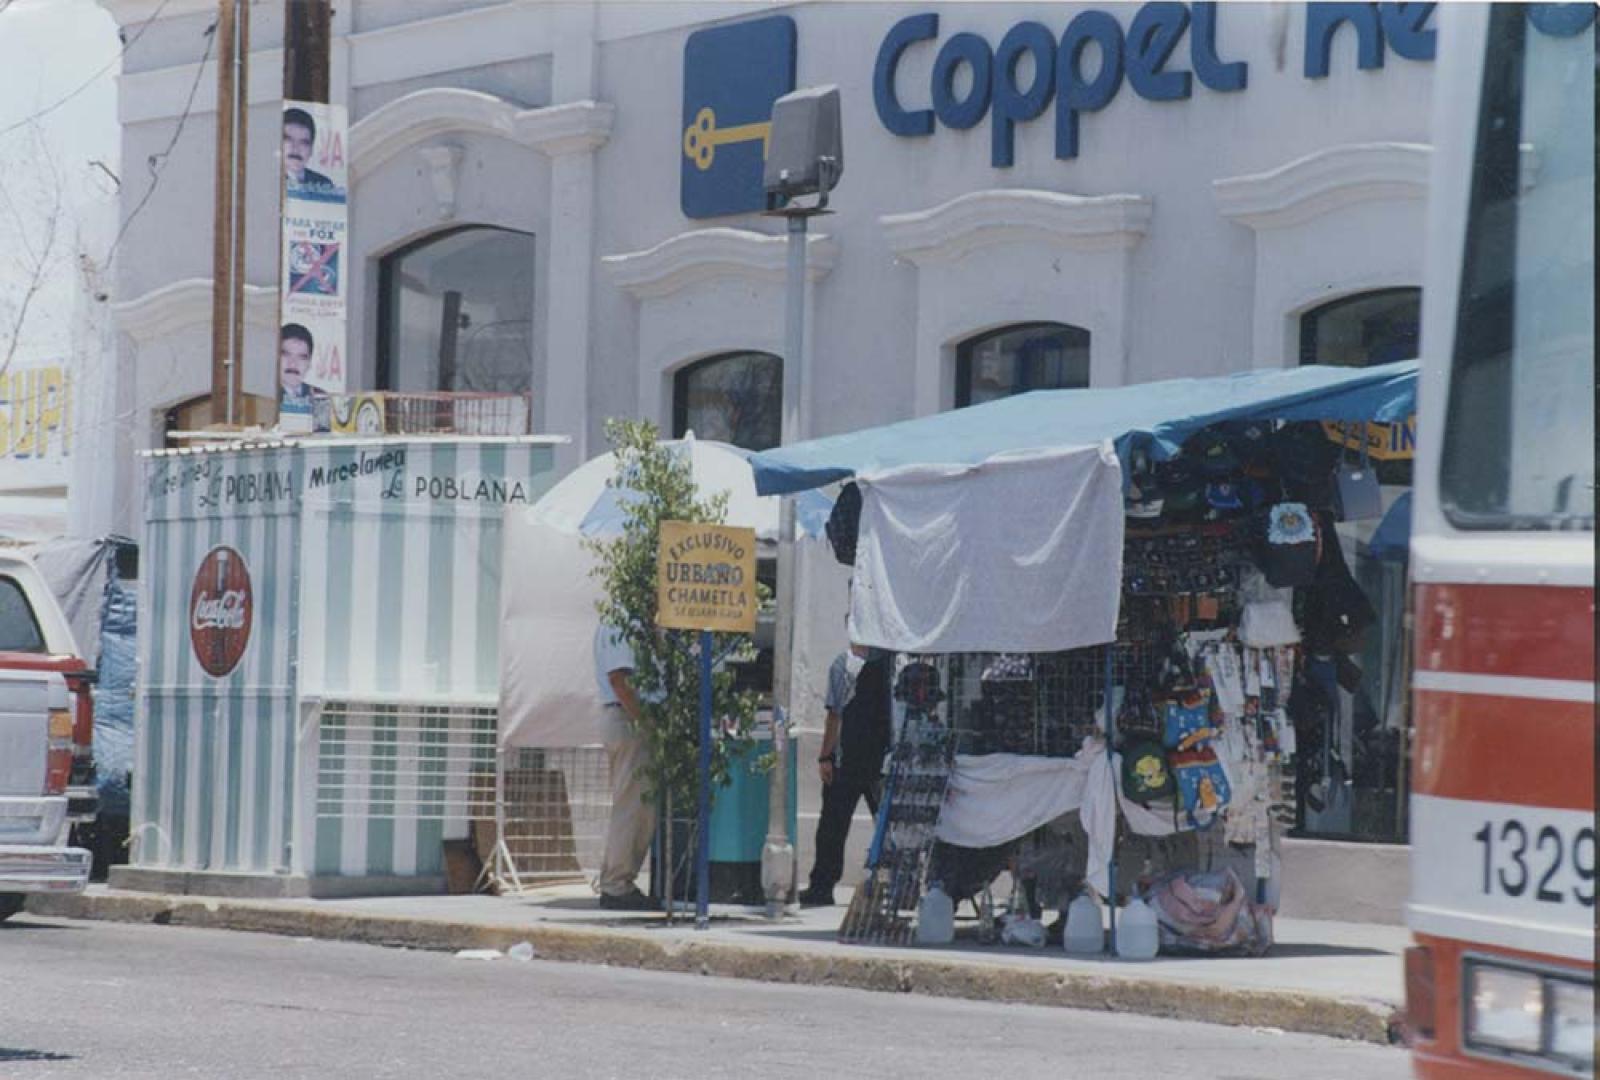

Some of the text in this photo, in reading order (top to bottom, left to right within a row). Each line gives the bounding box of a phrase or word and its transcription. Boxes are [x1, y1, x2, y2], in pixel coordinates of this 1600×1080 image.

[872, 2, 1248, 168] Coppel
[309, 228, 335, 240] FOX
[226, 469, 294, 504] POBLANA
[415, 475, 529, 504] POBLANA
[669, 533, 745, 560] EXCLUSIVO
[667, 562, 743, 585] URBANO
[668, 588, 747, 607] CHAMETLA
[1472, 818, 1595, 908] 1329
